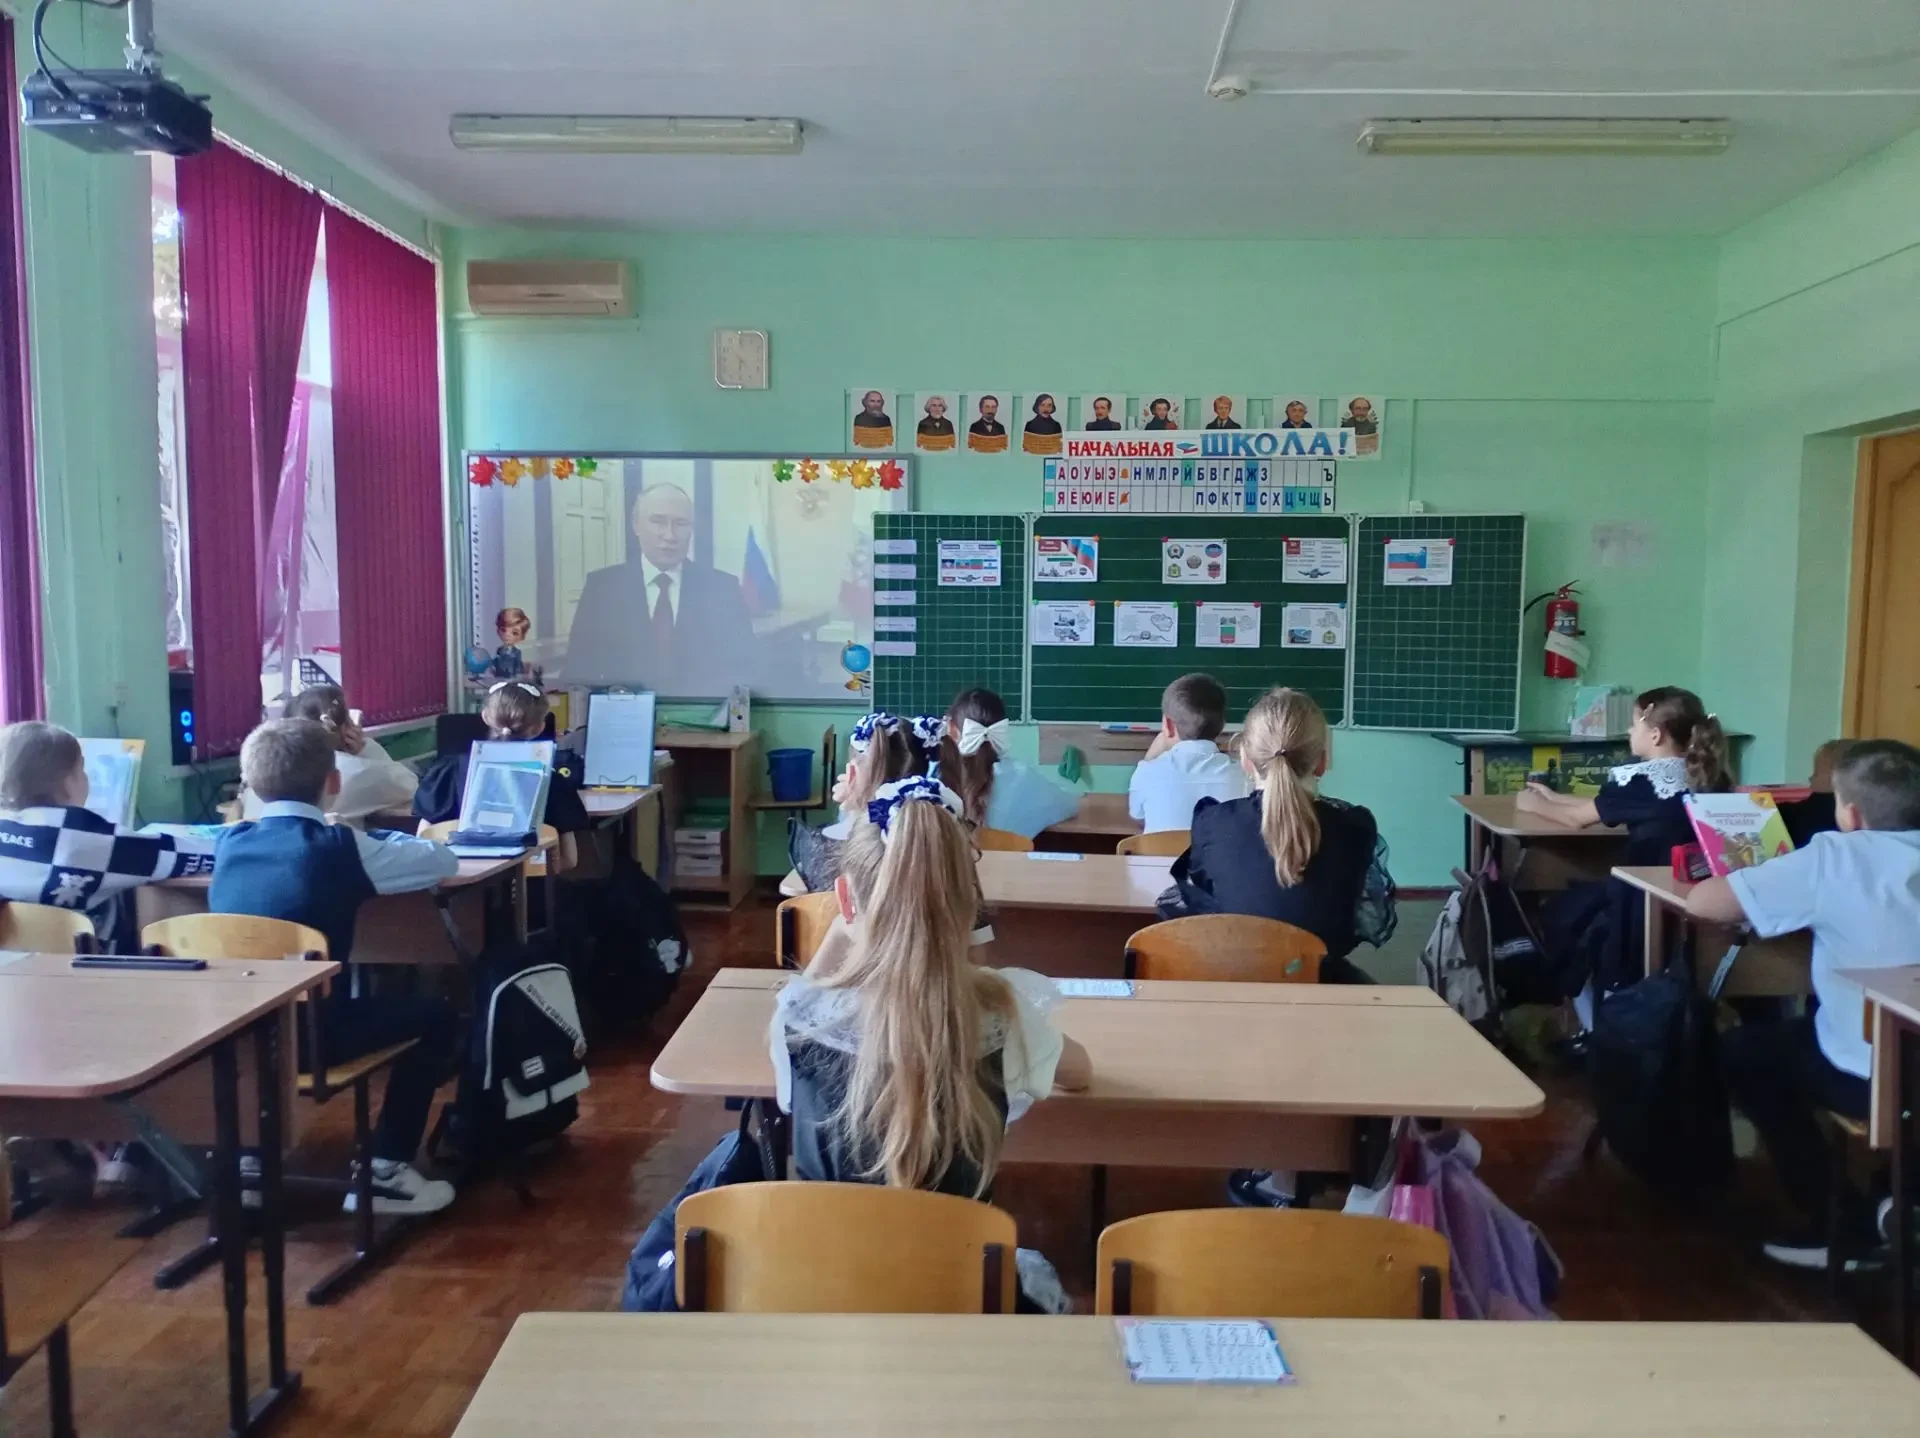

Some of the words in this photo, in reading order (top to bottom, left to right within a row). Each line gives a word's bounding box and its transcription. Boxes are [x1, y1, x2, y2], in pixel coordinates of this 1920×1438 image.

[1067, 441, 1174, 457] НАЧАЛЬНАЯ
[1200, 431, 1348, 457] ШКОЛА!
[1058, 467, 1066, 480] А
[1070, 467, 1079, 480] О
[1084, 467, 1091, 480] У
[1095, 467, 1105, 480] Ы
[1108, 467, 1116, 480] Э
[1133, 467, 1141, 480] Н
[1146, 467, 1155, 480] М
[1158, 467, 1167, 480] Л
[1172, 467, 1180, 480] Р
[1184, 465, 1192, 481] Й
[1197, 467, 1205, 481] Б
[1210, 467, 1218, 481] В
[1223, 467, 1230, 481] Г
[1234, 467, 1244, 484] Д
[1246, 467, 1257, 481] Ж
[1260, 467, 1268, 481] З
[1323, 468, 1333, 482] Ъ
[1057, 492, 1065, 504] Я
[1081, 492, 1092, 504] Ю
[1095, 492, 1102, 504] И
[1108, 492, 1115, 504] Е
[1196, 492, 1204, 505] П
[1208, 491, 1217, 505] Ф
[1222, 492, 1229, 505] К
[1234, 492, 1242, 505] Т
[1245, 492, 1257, 506] Ш
[1260, 492, 1268, 506] С
[1272, 492, 1280, 506] Х
[1285, 492, 1294, 508] Ц
[1298, 492, 1306, 506] Ч
[1309, 492, 1320, 508] Щ
[1323, 492, 1332, 506] Ь
